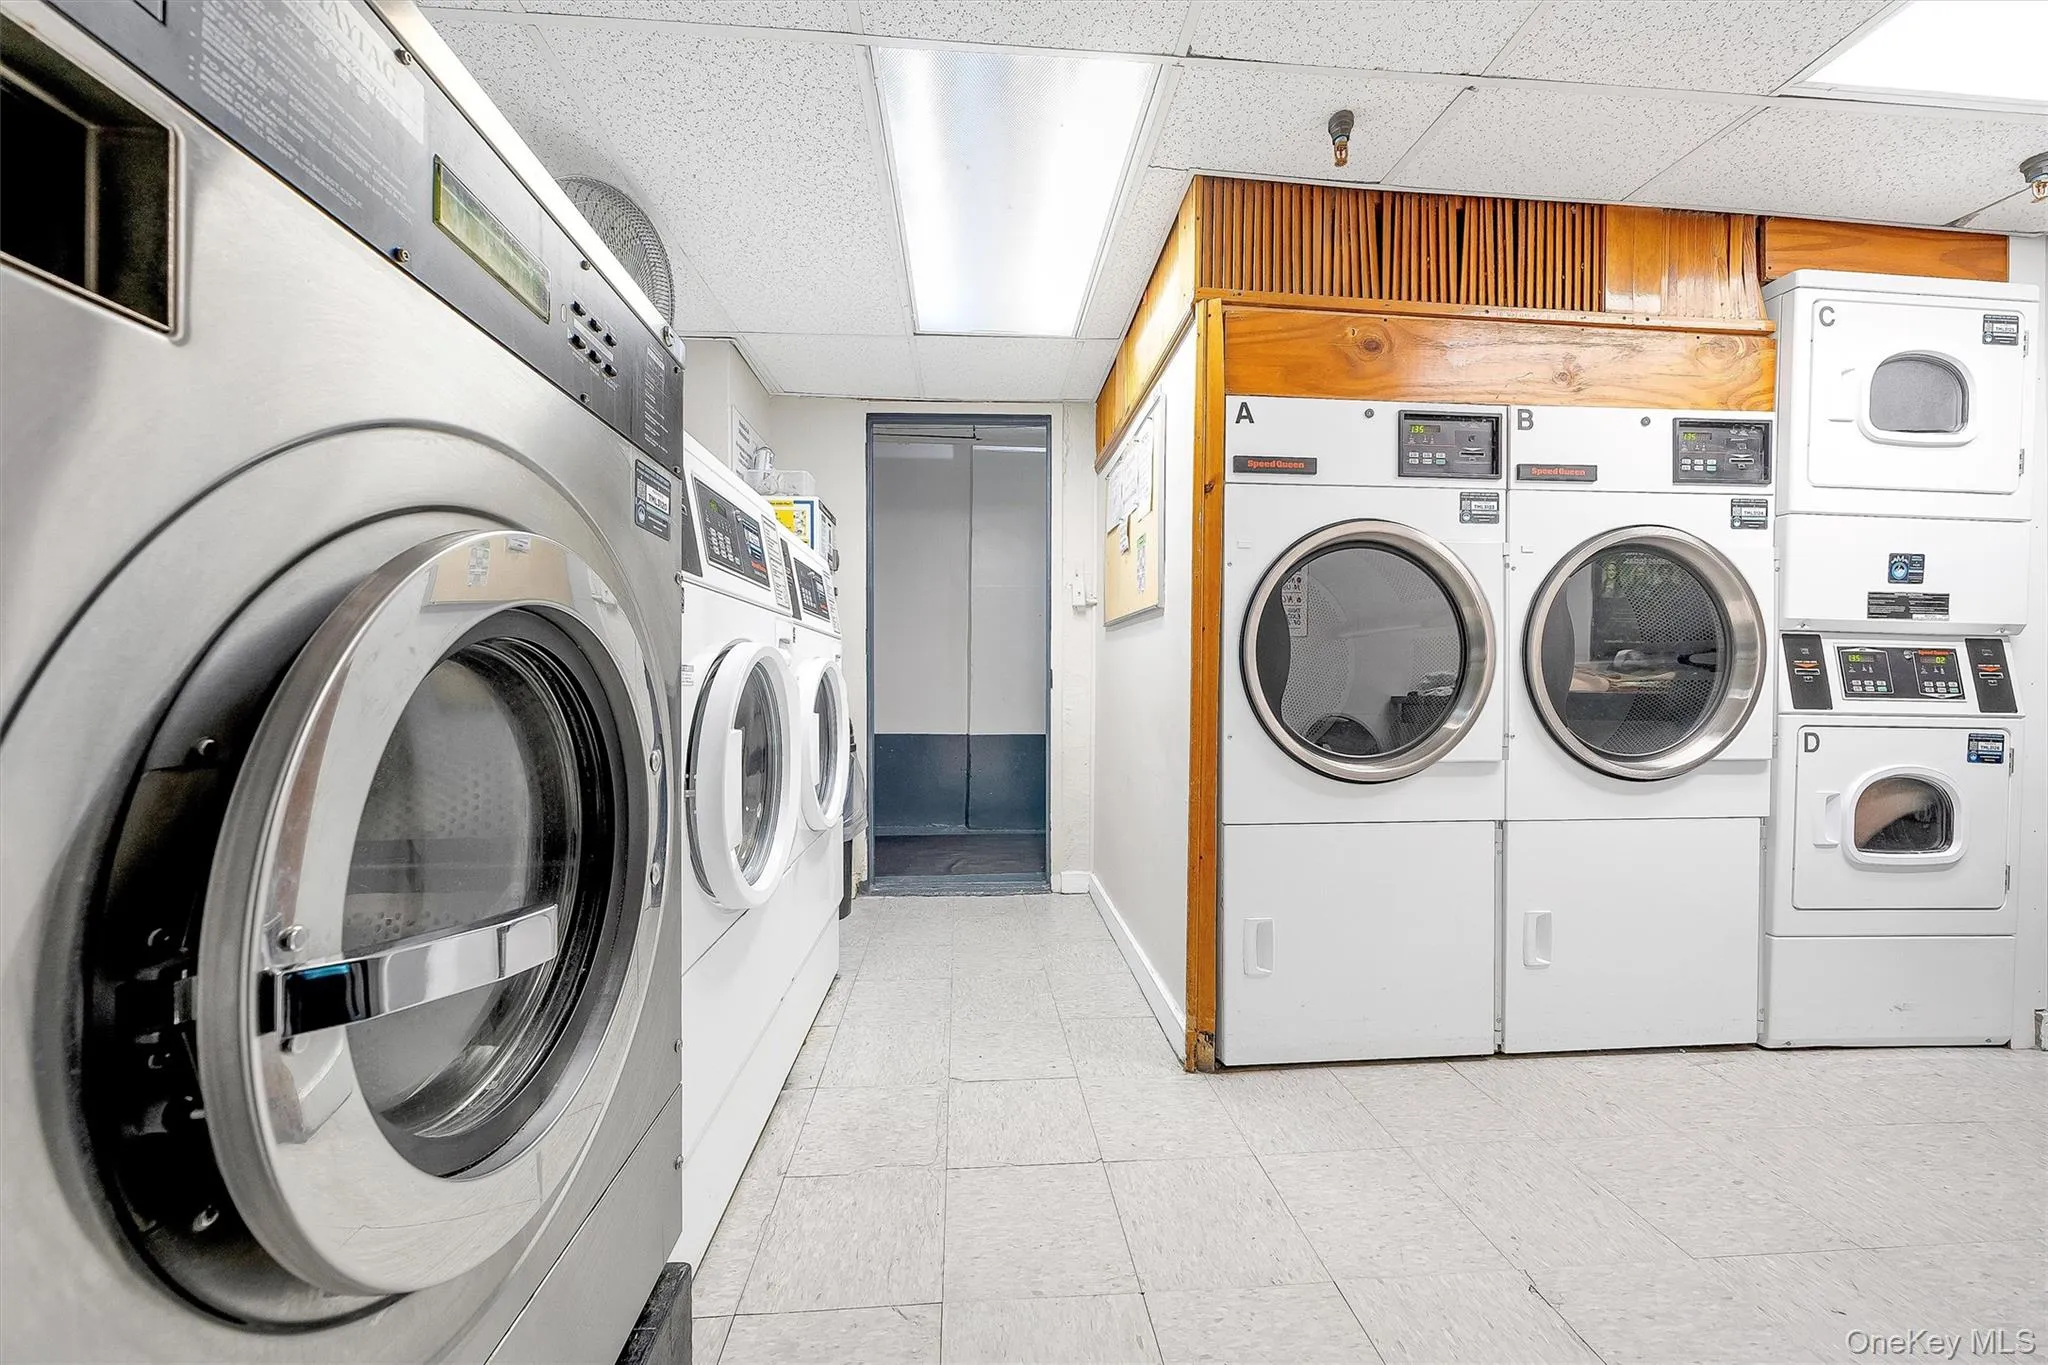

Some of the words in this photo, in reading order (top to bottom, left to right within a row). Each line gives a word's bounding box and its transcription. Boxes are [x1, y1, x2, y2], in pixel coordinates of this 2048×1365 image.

[1819, 306, 1836, 327] C
[1235, 401, 1255, 424] A
[1517, 409, 1534, 431] B
[1247, 459, 1276, 469] Speed
[1276, 460, 1305, 469] Queen
[1531, 467, 1558, 476] Speed
[1558, 468, 1586, 476] Queen
[1804, 732, 1820, 753] D
